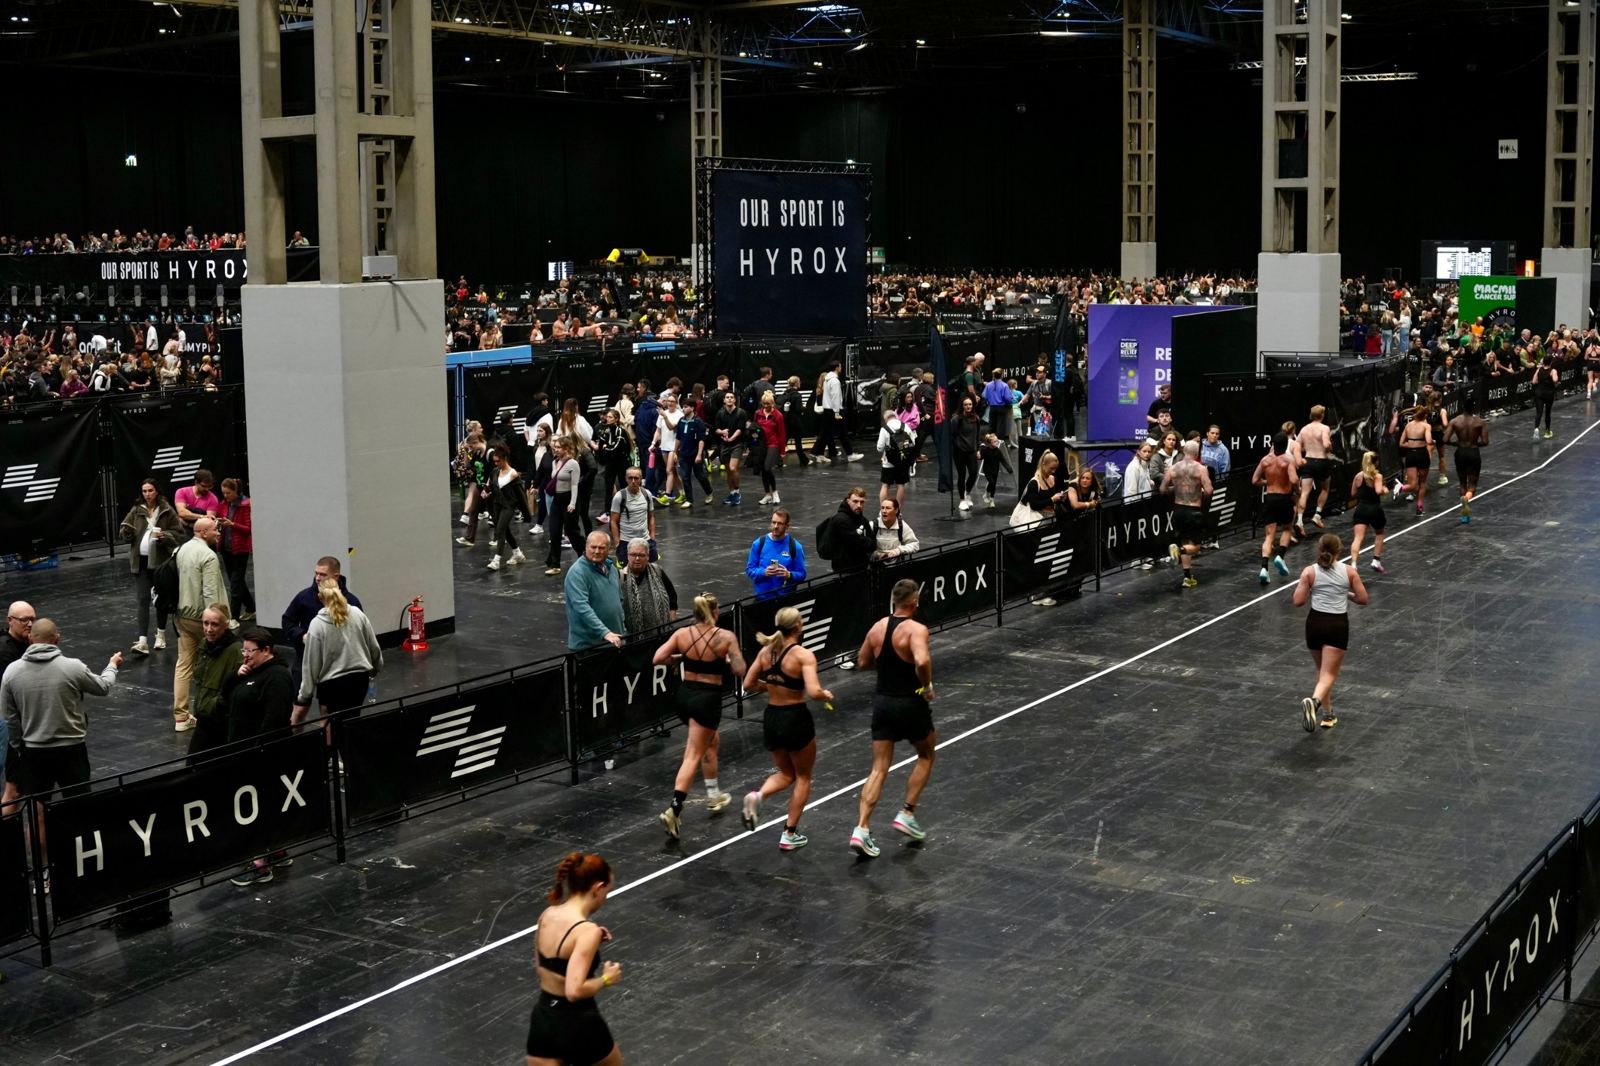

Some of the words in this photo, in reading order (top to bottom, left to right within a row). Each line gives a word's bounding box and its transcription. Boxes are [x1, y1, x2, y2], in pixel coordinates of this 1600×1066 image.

[740, 198, 769, 227] OUR
[780, 198, 824, 227] SPORT
[832, 199, 846, 227] IS
[101, 261, 118, 280] OUR
[120, 261, 148, 280] SPORT
[150, 260, 159, 280] IS
[740, 246, 848, 277] HYROX
[1003, 366, 1030, 378] HYRO
[1231, 434, 1297, 450] HYR
[1107, 510, 1175, 549] HYROX
[592, 661, 685, 718] HYR
[75, 769, 307, 877] HYROX
[1458, 888, 1561, 1052] HYROX
